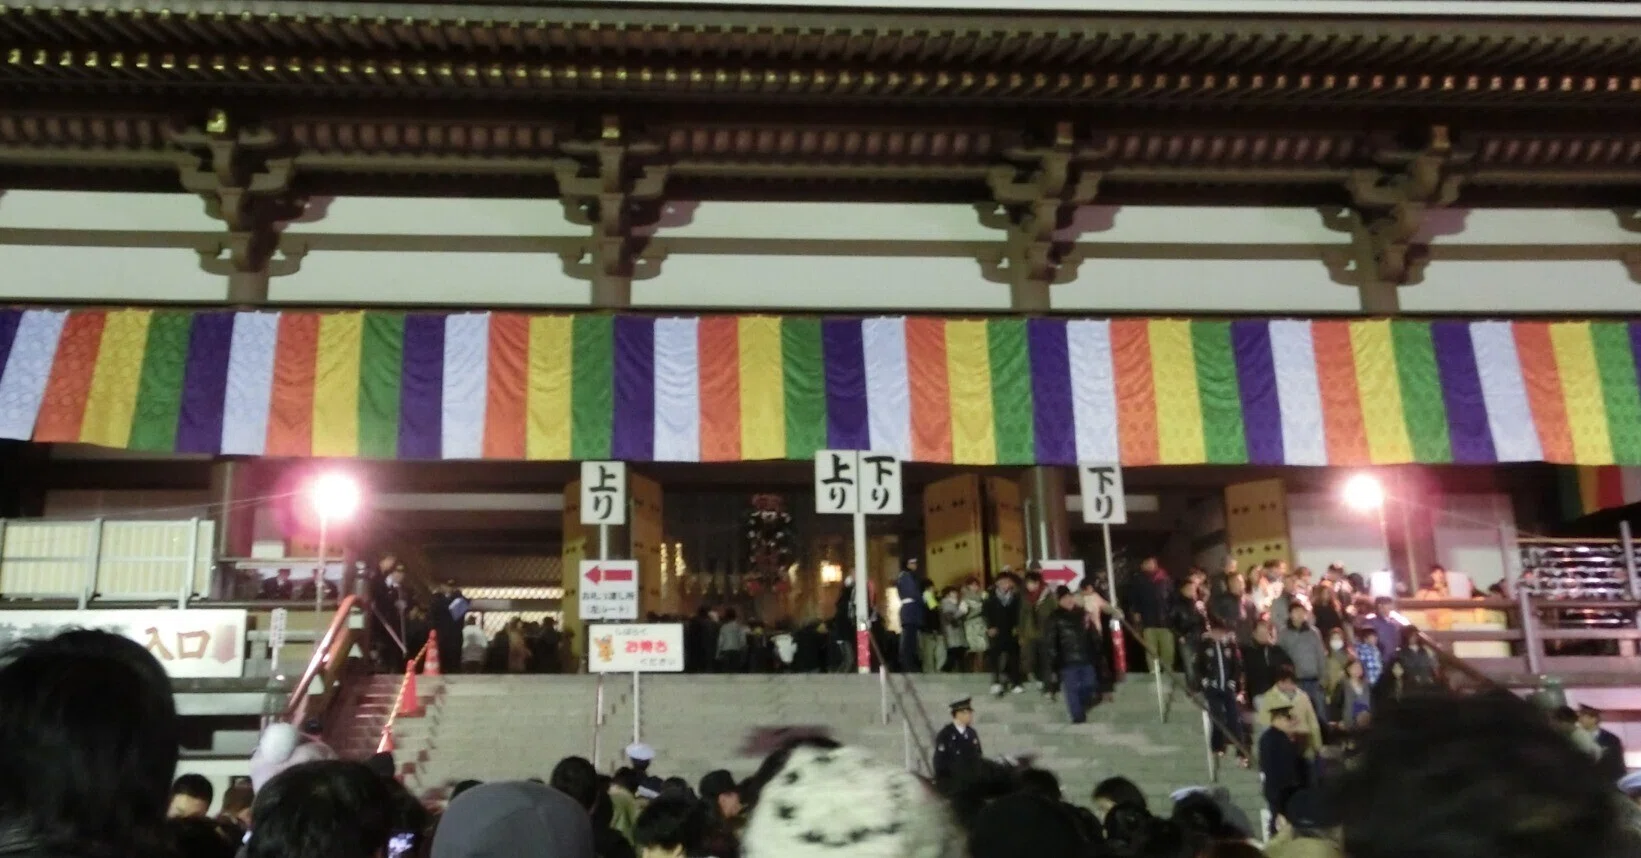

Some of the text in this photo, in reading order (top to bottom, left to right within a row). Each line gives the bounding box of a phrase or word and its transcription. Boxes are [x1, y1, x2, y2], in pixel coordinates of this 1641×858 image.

[589, 466, 617, 520] 上り
[822, 454, 853, 509] 上り
[863, 456, 895, 510] 下り
[1088, 466, 1115, 520] 下り
[145, 626, 211, 661] 入口
[625, 640, 668, 653] お待ち
[640, 658, 676, 666] ください
